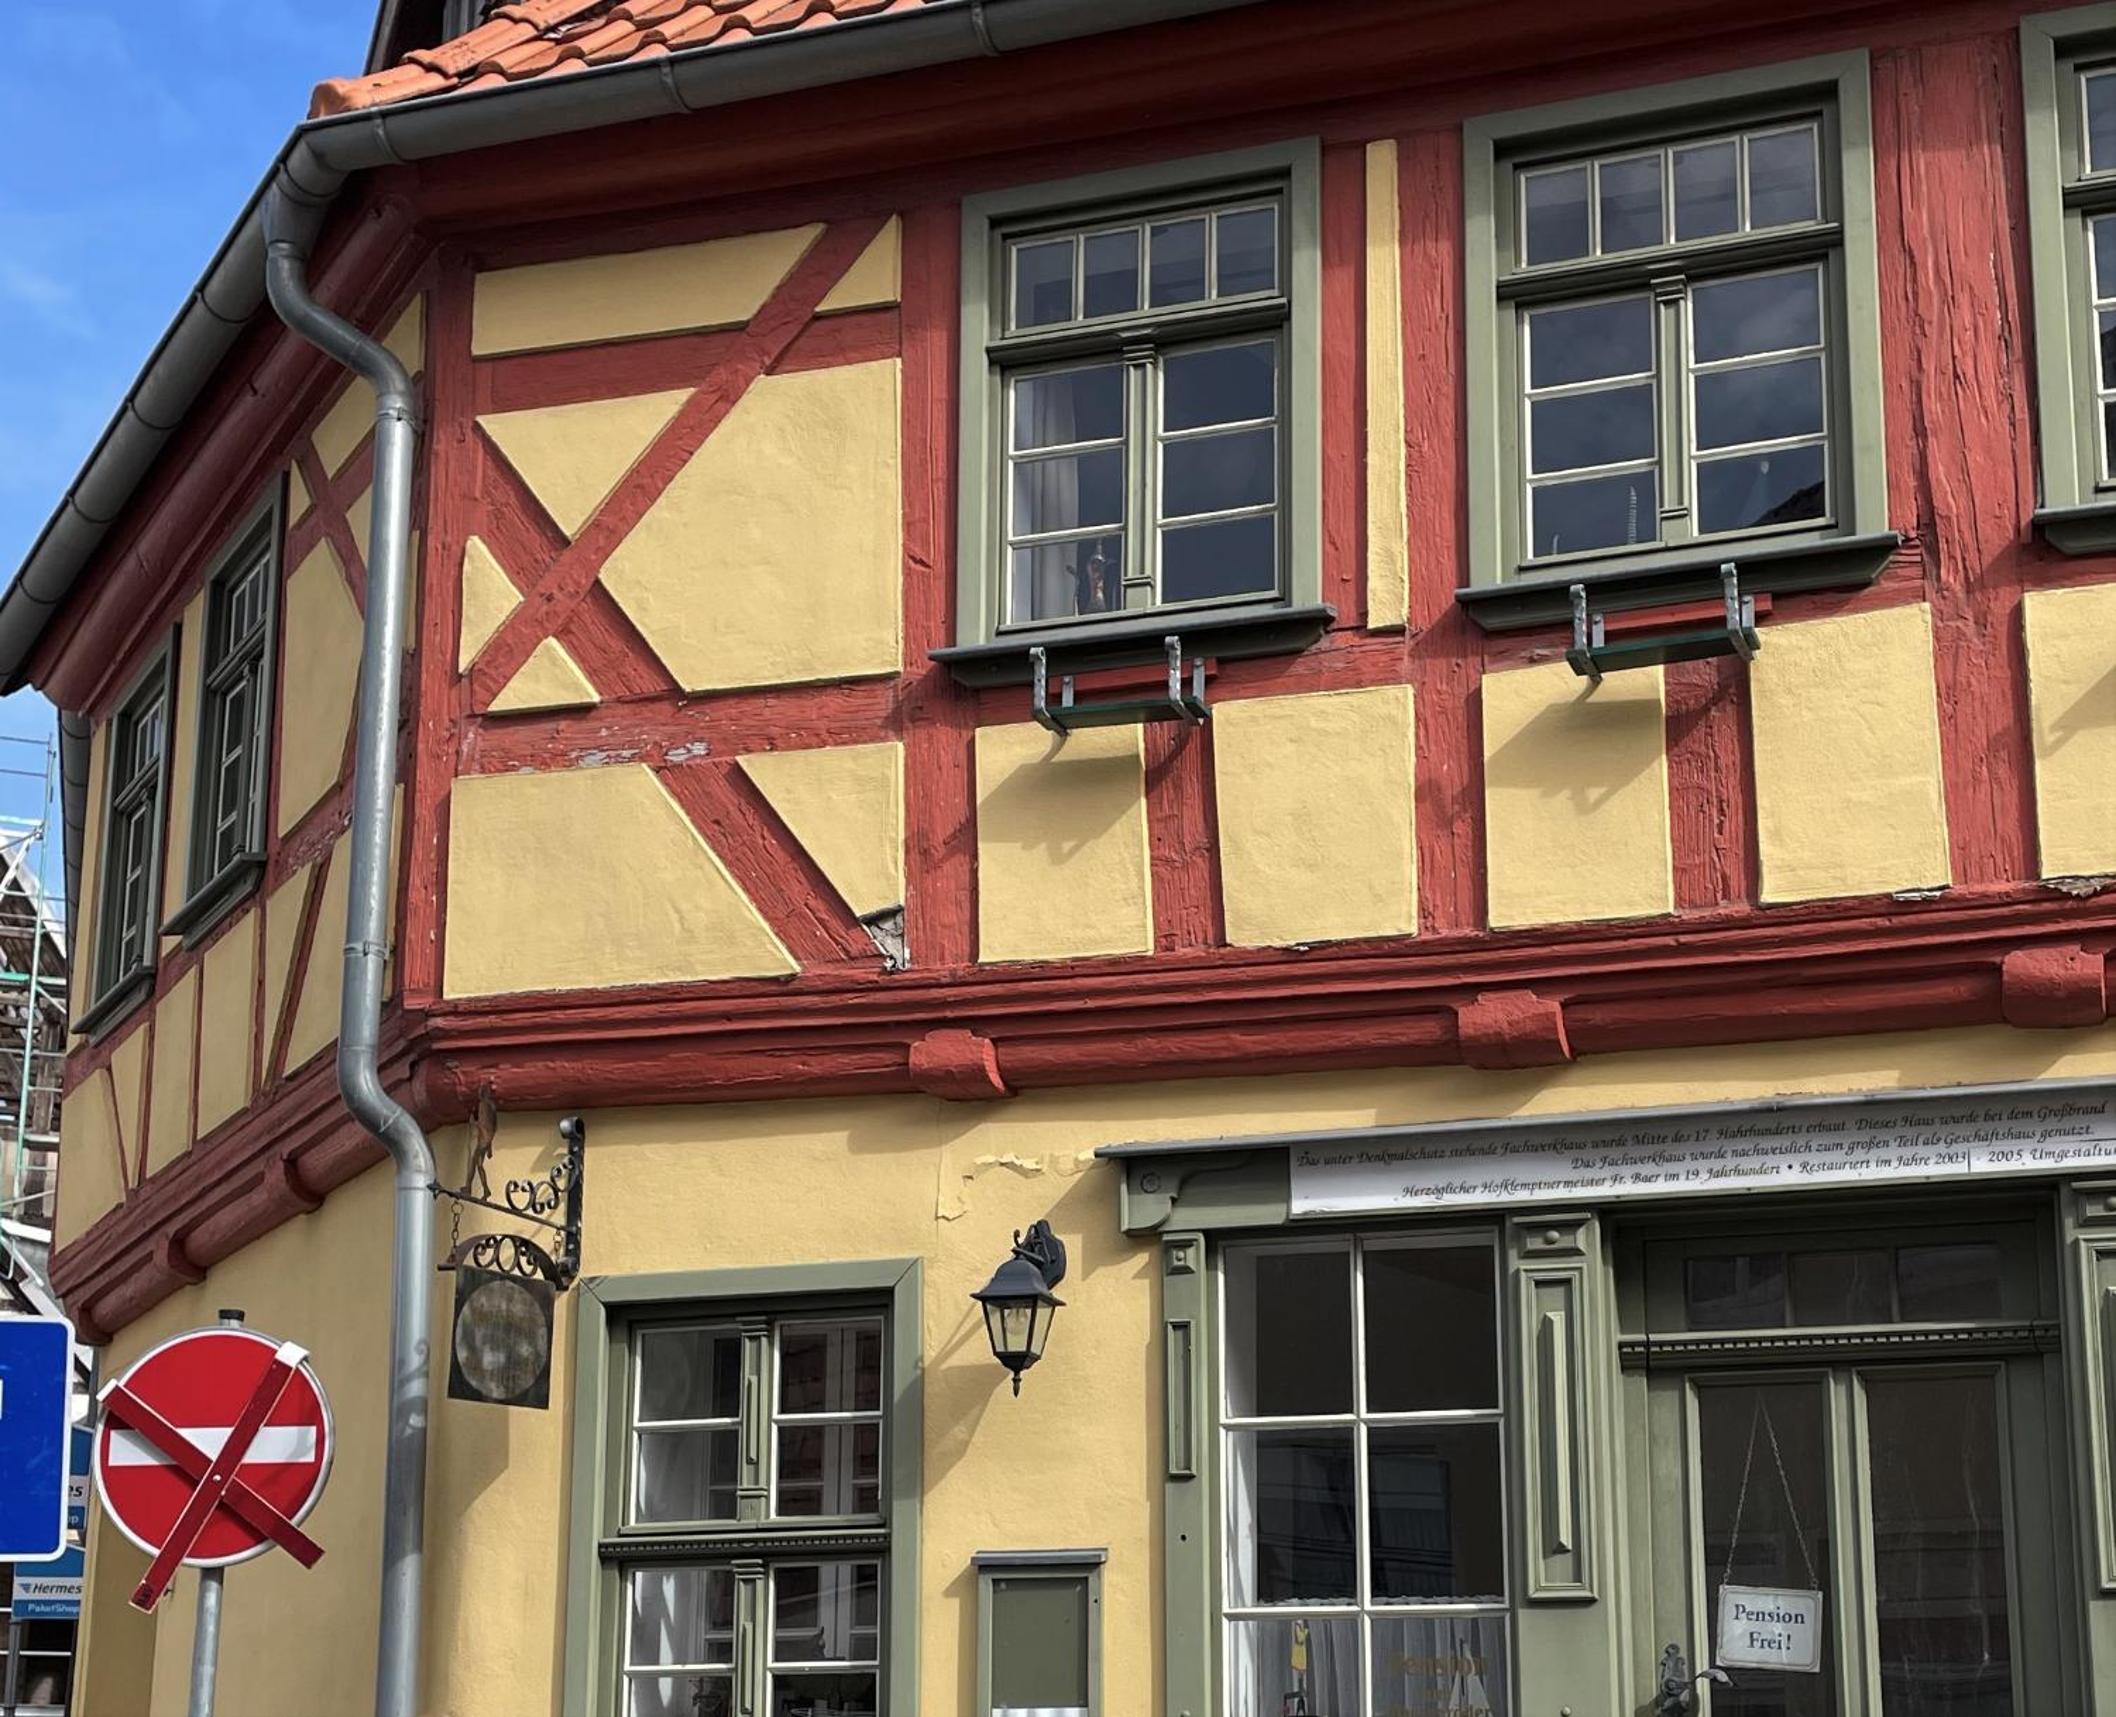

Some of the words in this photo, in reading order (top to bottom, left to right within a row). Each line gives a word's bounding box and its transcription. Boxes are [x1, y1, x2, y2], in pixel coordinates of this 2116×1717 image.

[1358, 1147, 1445, 1166] Denkmalschutz
[1449, 1142, 1497, 1158] stehende
[1500, 1137, 1587, 1157] Fachwerkhaus
[1590, 1134, 1627, 1149] wurde
[1632, 1132, 1669, 1146] Mitte
[1671, 1129, 1690, 1143] des
[1854, 1116, 1897, 1131] Dieses
[1901, 1115, 1935, 1128] Haus
[1939, 1110, 1978, 1126] wurde
[1983, 1107, 2003, 1122] bei
[2007, 1106, 2034, 1120] dem
[2036, 1101, 2109, 1122] Großbrand
[1571, 1157, 1596, 1169] Das
[1600, 1149, 1686, 1169] Fachwerkhaus
[1690, 1145, 1727, 1162] wurde
[1731, 1141, 1812, 1158] nachweislich
[1815, 1141, 1845, 1153] zum
[1845, 1135, 1890, 1156] großen
[1893, 1133, 1919, 1148] Teil
[1922, 1131, 1942, 1146] als
[1988, 1150, 2024, 1163] 2005
[1609, 1173, 1626, 1187] Fr.
[1631, 1170, 1661, 1184] Baer
[1664, 1170, 1679, 1182] im
[1702, 1161, 1780, 1183] Jahrhundert
[1799, 1157, 1870, 1175] Restauriert
[1875, 1155, 1892, 1168] im
[1893, 1151, 1930, 1168] Jahre
[1933, 1151, 1967, 1165] 2003
[32, 1582, 82, 1594] Hermes
[1733, 1603, 1806, 1625] Pension
